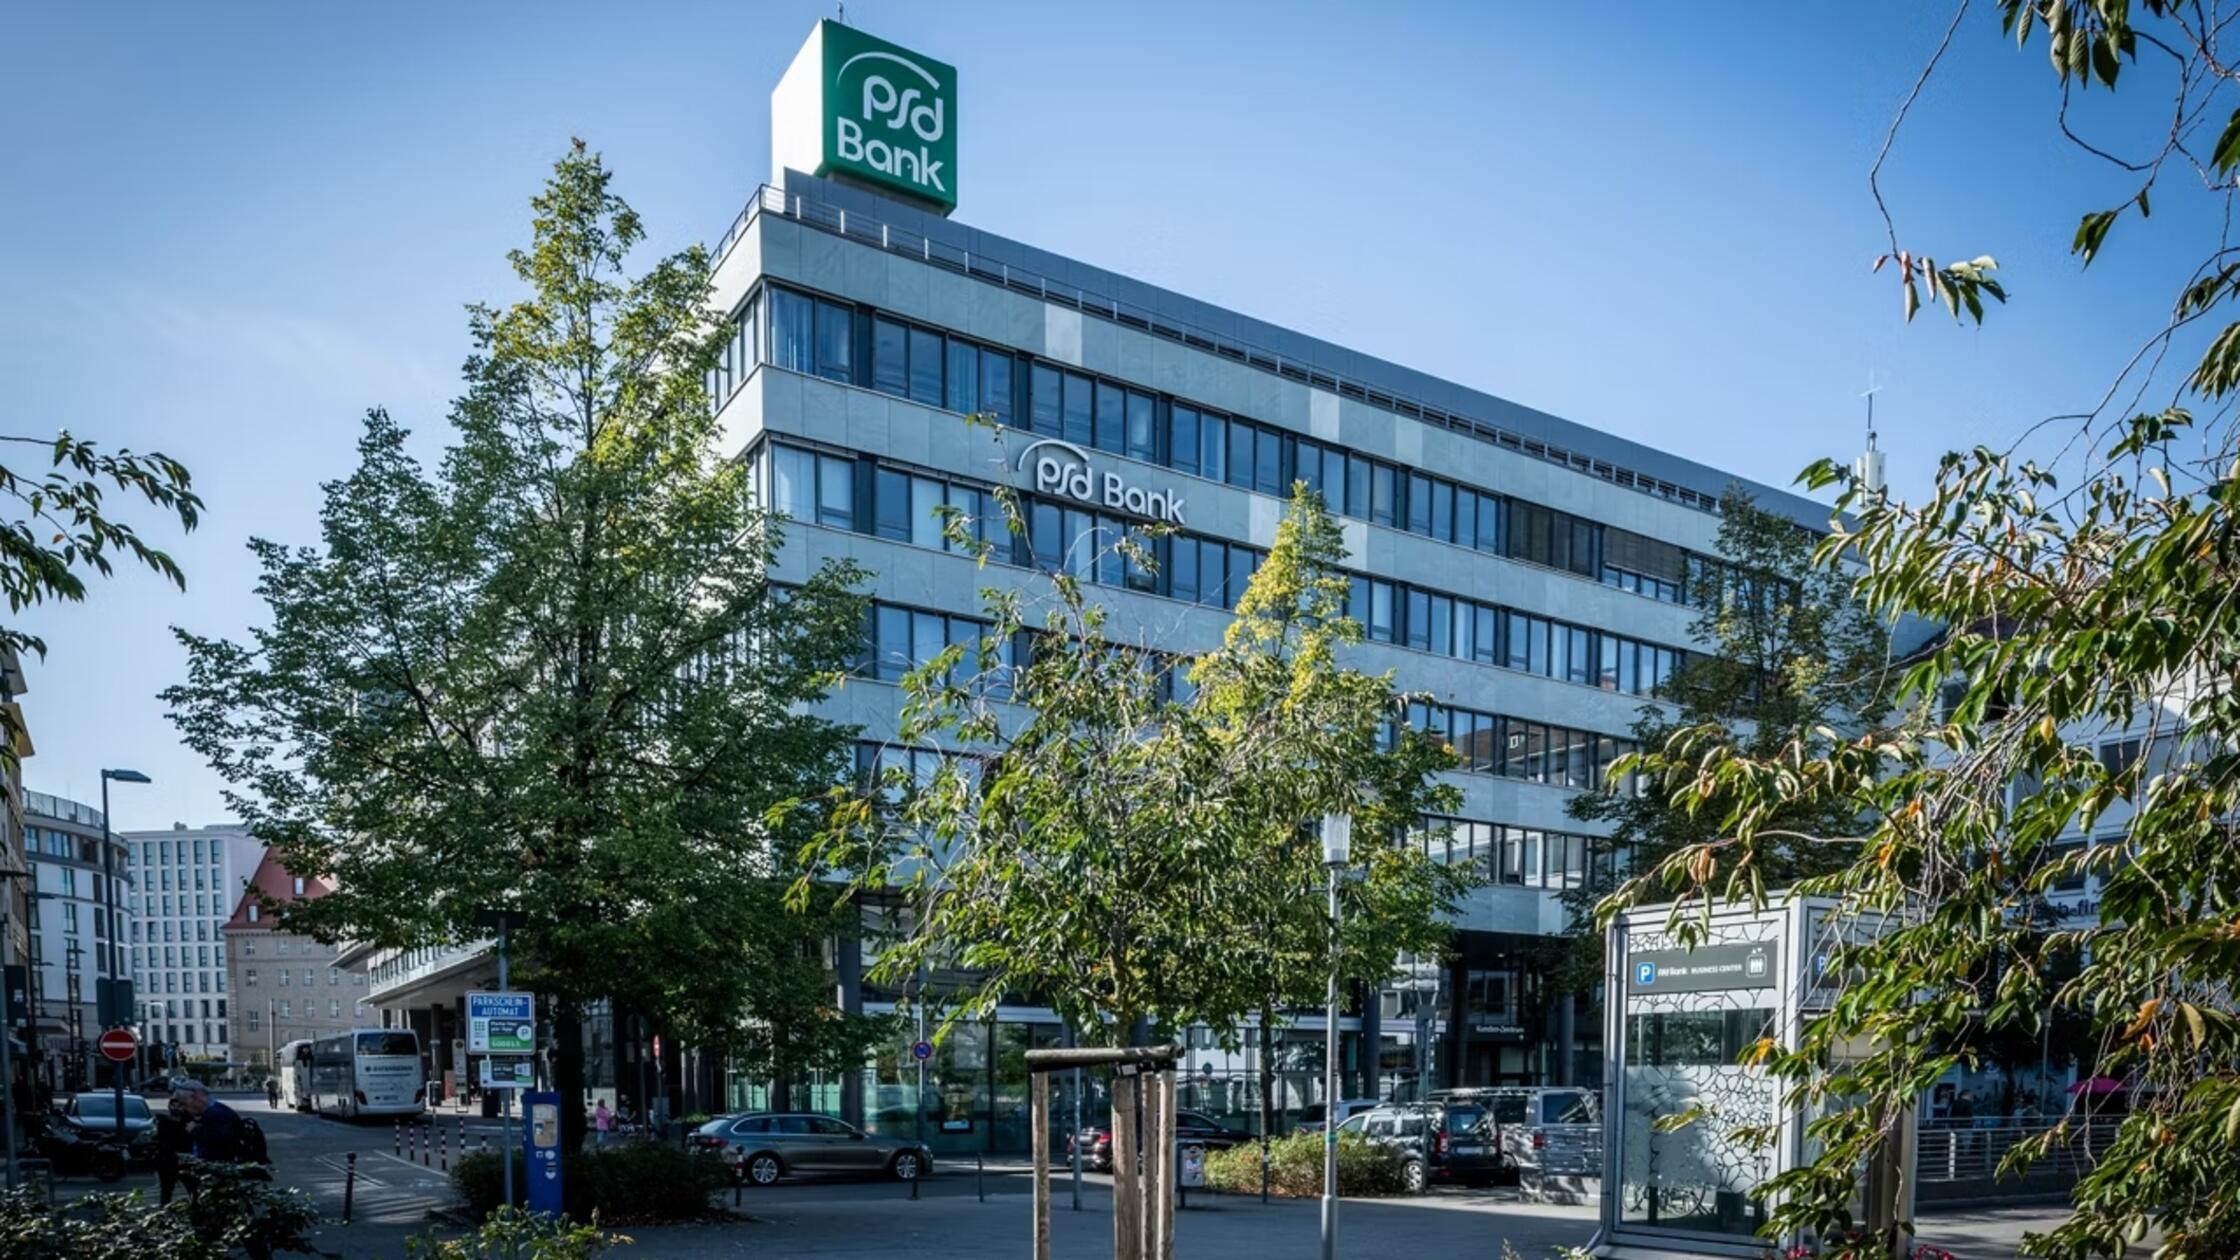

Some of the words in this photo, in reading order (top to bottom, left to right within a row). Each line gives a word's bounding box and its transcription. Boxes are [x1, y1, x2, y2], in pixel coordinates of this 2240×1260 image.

[863, 75, 944, 142] psd
[837, 116, 946, 192] Bank
[1036, 457, 1094, 500] psd
[1103, 472, 1185, 525] Bank
[1719, 963, 1742, 973] CENTER
[472, 996, 528, 1007] PARKSCHEIN-
[481, 1007, 519, 1016] AUTOMAT
